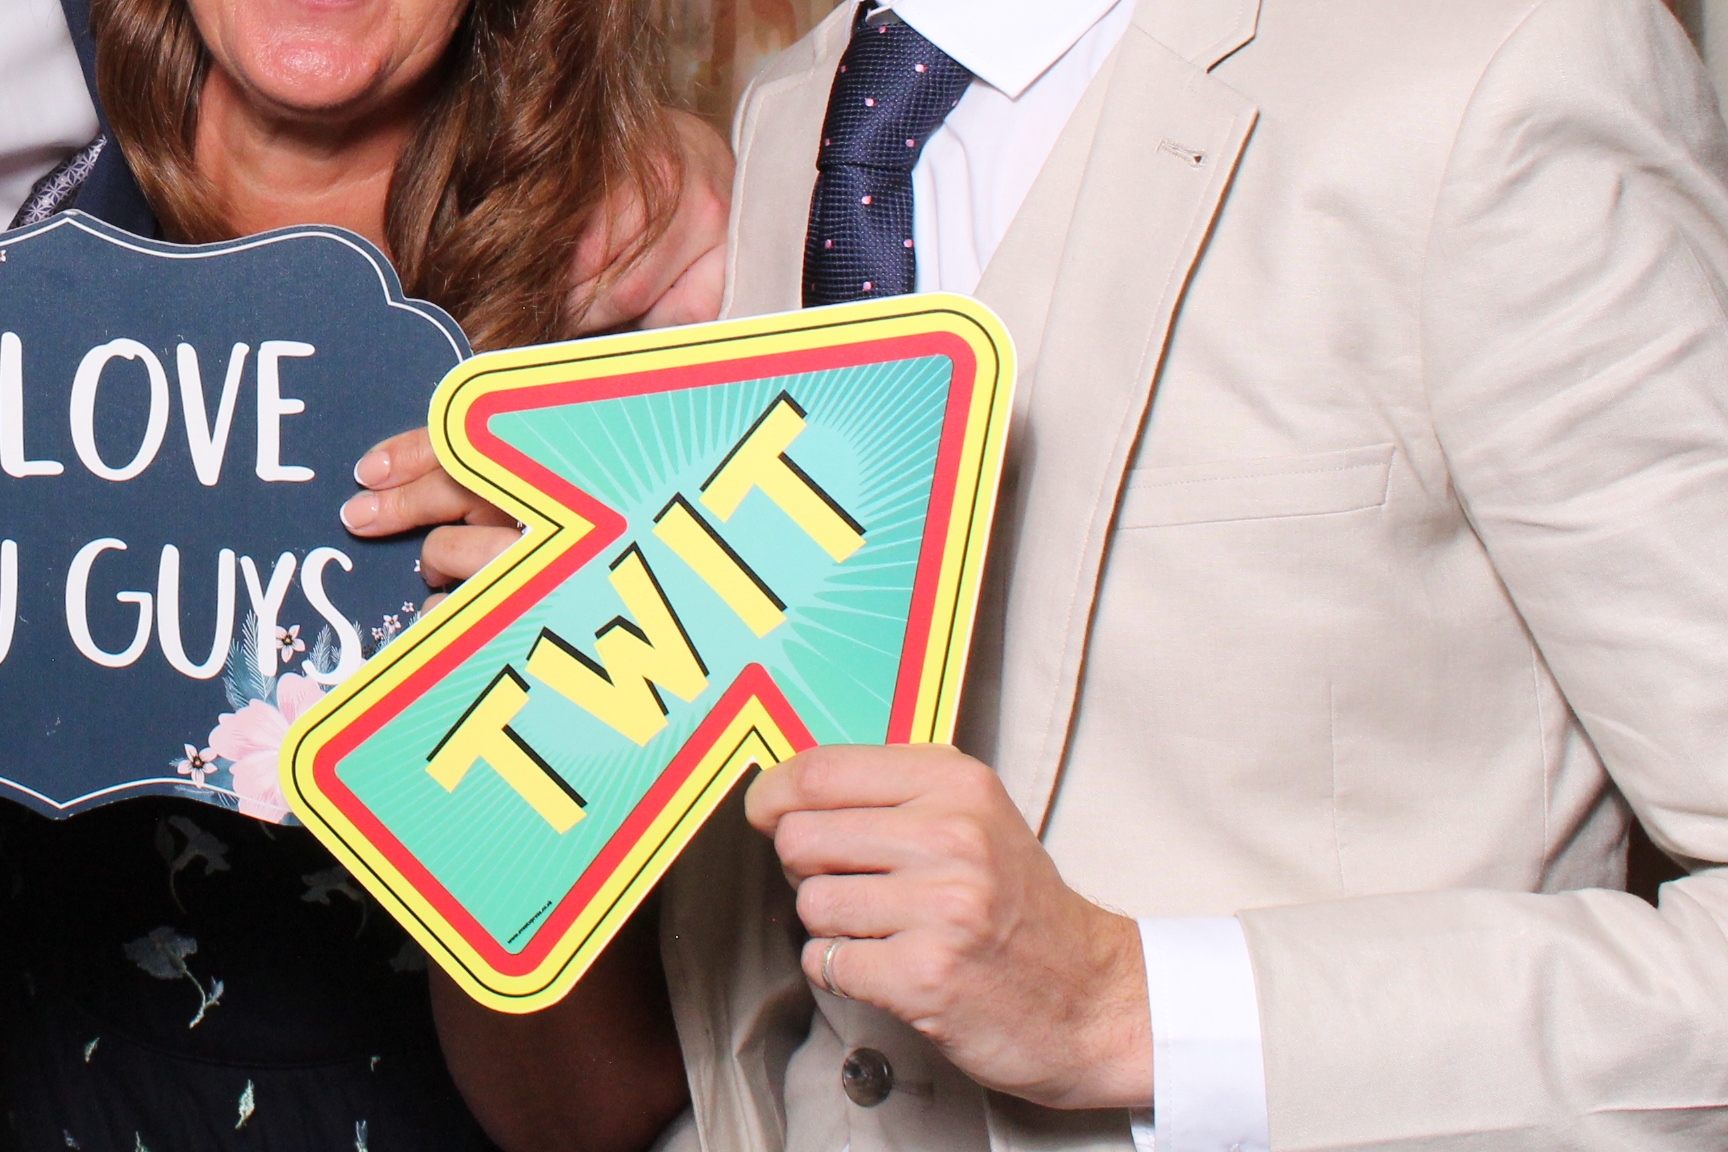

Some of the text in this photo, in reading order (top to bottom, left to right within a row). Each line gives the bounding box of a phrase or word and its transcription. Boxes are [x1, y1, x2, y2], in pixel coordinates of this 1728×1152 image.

[0, 331, 317, 487] LOVE
[65, 538, 362, 686] GUYS
[424, 389, 867, 835] TWIT
